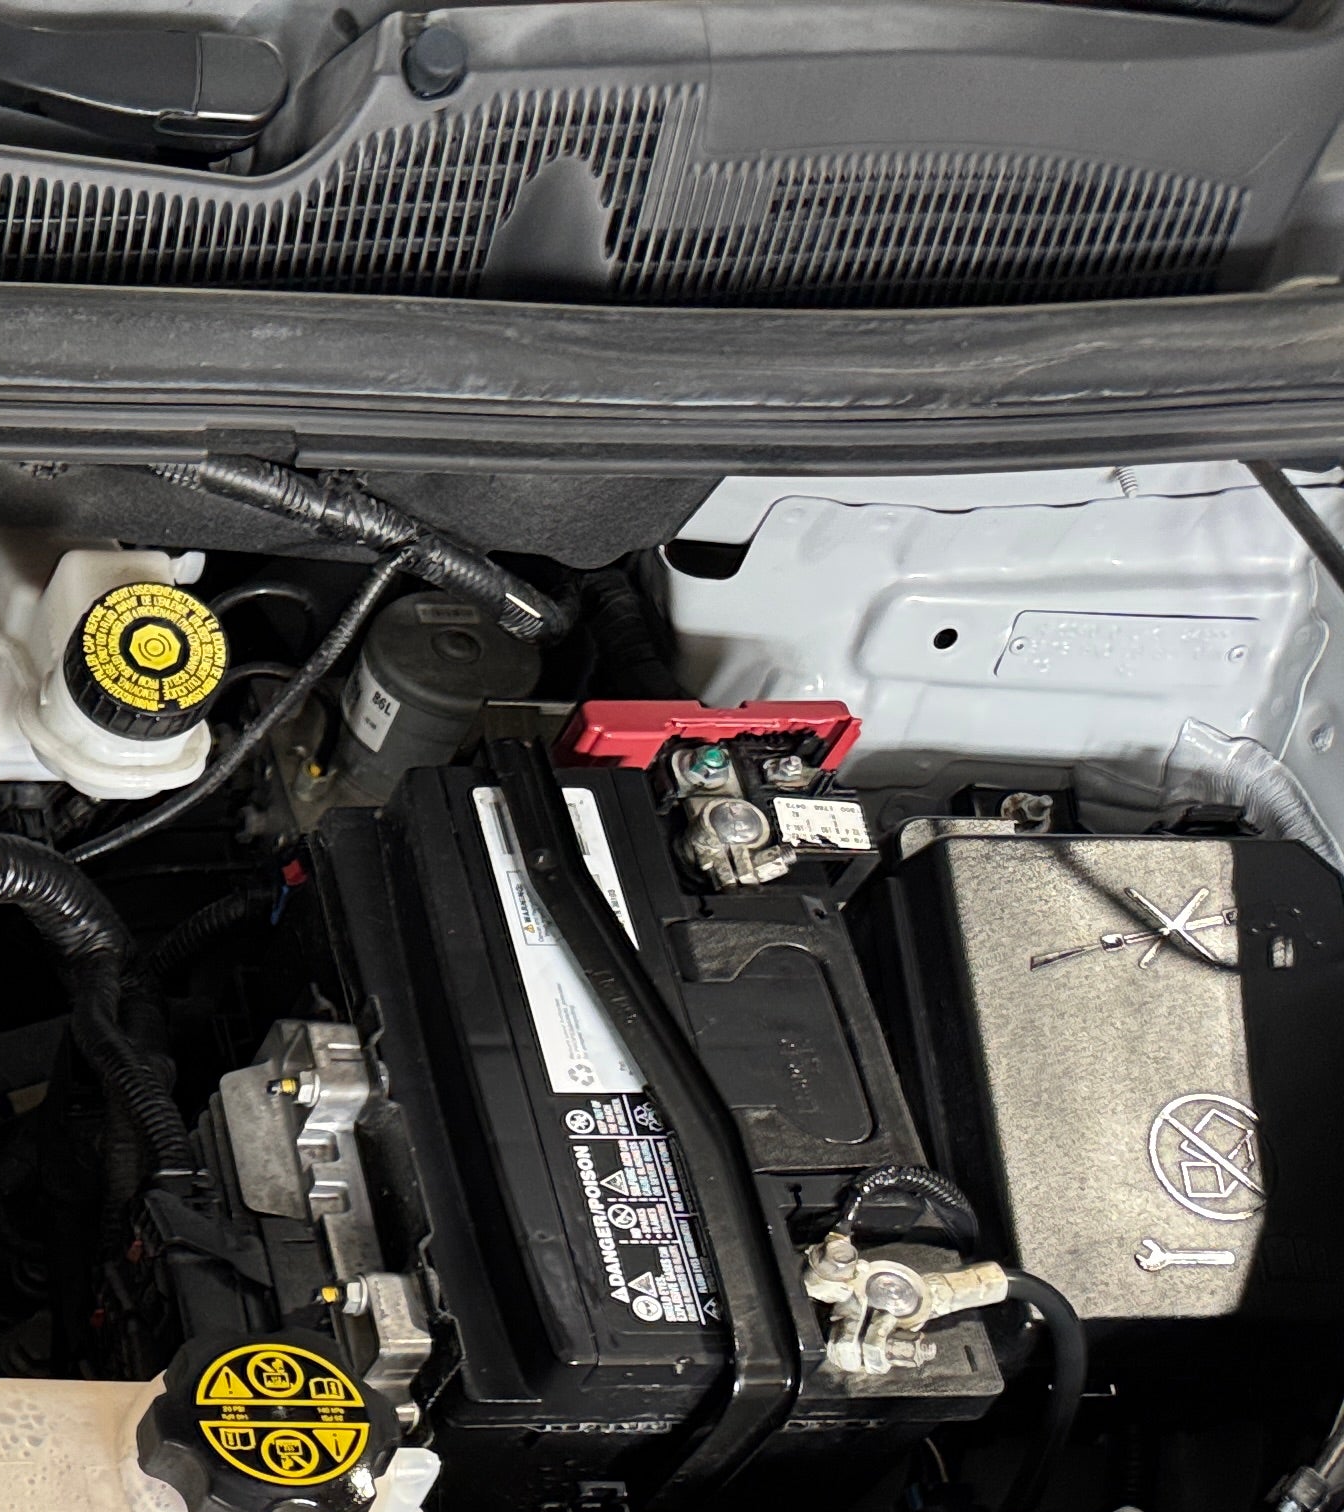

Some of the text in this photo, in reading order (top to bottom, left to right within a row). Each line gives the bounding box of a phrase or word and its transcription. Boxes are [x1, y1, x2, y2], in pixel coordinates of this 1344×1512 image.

[83, 603, 107, 634] BEFORE
[203, 617, 219, 631] LE
[82, 634, 95, 653] CAP
[101, 662, 120, 680] USE
[573, 1146, 625, 1286] DANGER/POISON
